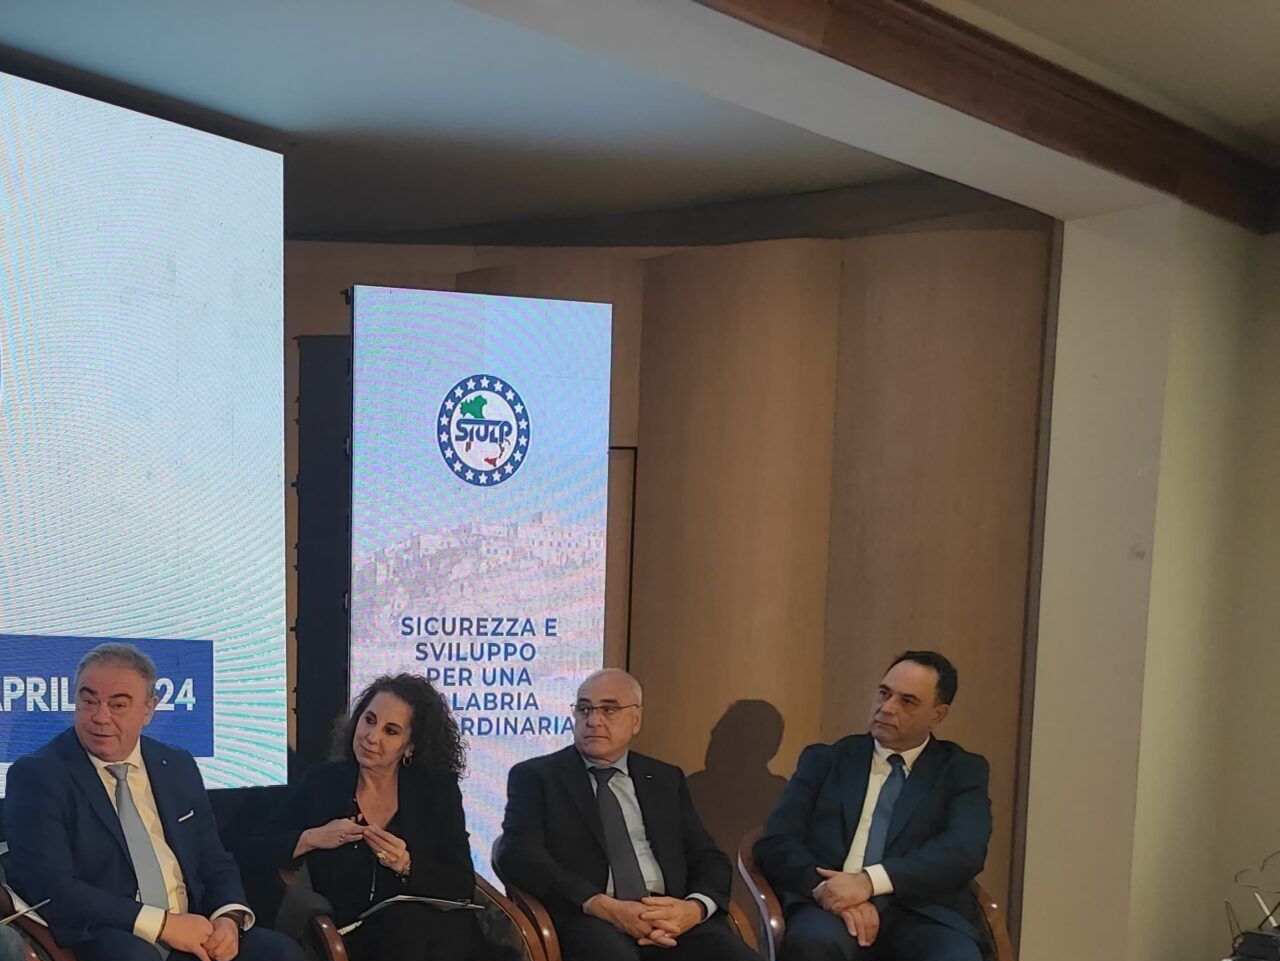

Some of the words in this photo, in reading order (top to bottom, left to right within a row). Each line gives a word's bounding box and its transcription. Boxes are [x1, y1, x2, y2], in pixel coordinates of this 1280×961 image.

[455, 418, 513, 443] SIULP
[401, 616, 536, 637] SICUREZZA
[545, 618, 558, 637] E
[415, 642, 537, 662] SVILUPPO
[426, 668, 473, 687] PER
[482, 668, 533, 687] UNA
[154, 677, 197, 711] 24
[444, 692, 540, 711] LABRIA
[461, 716, 576, 736] RDINARIA
